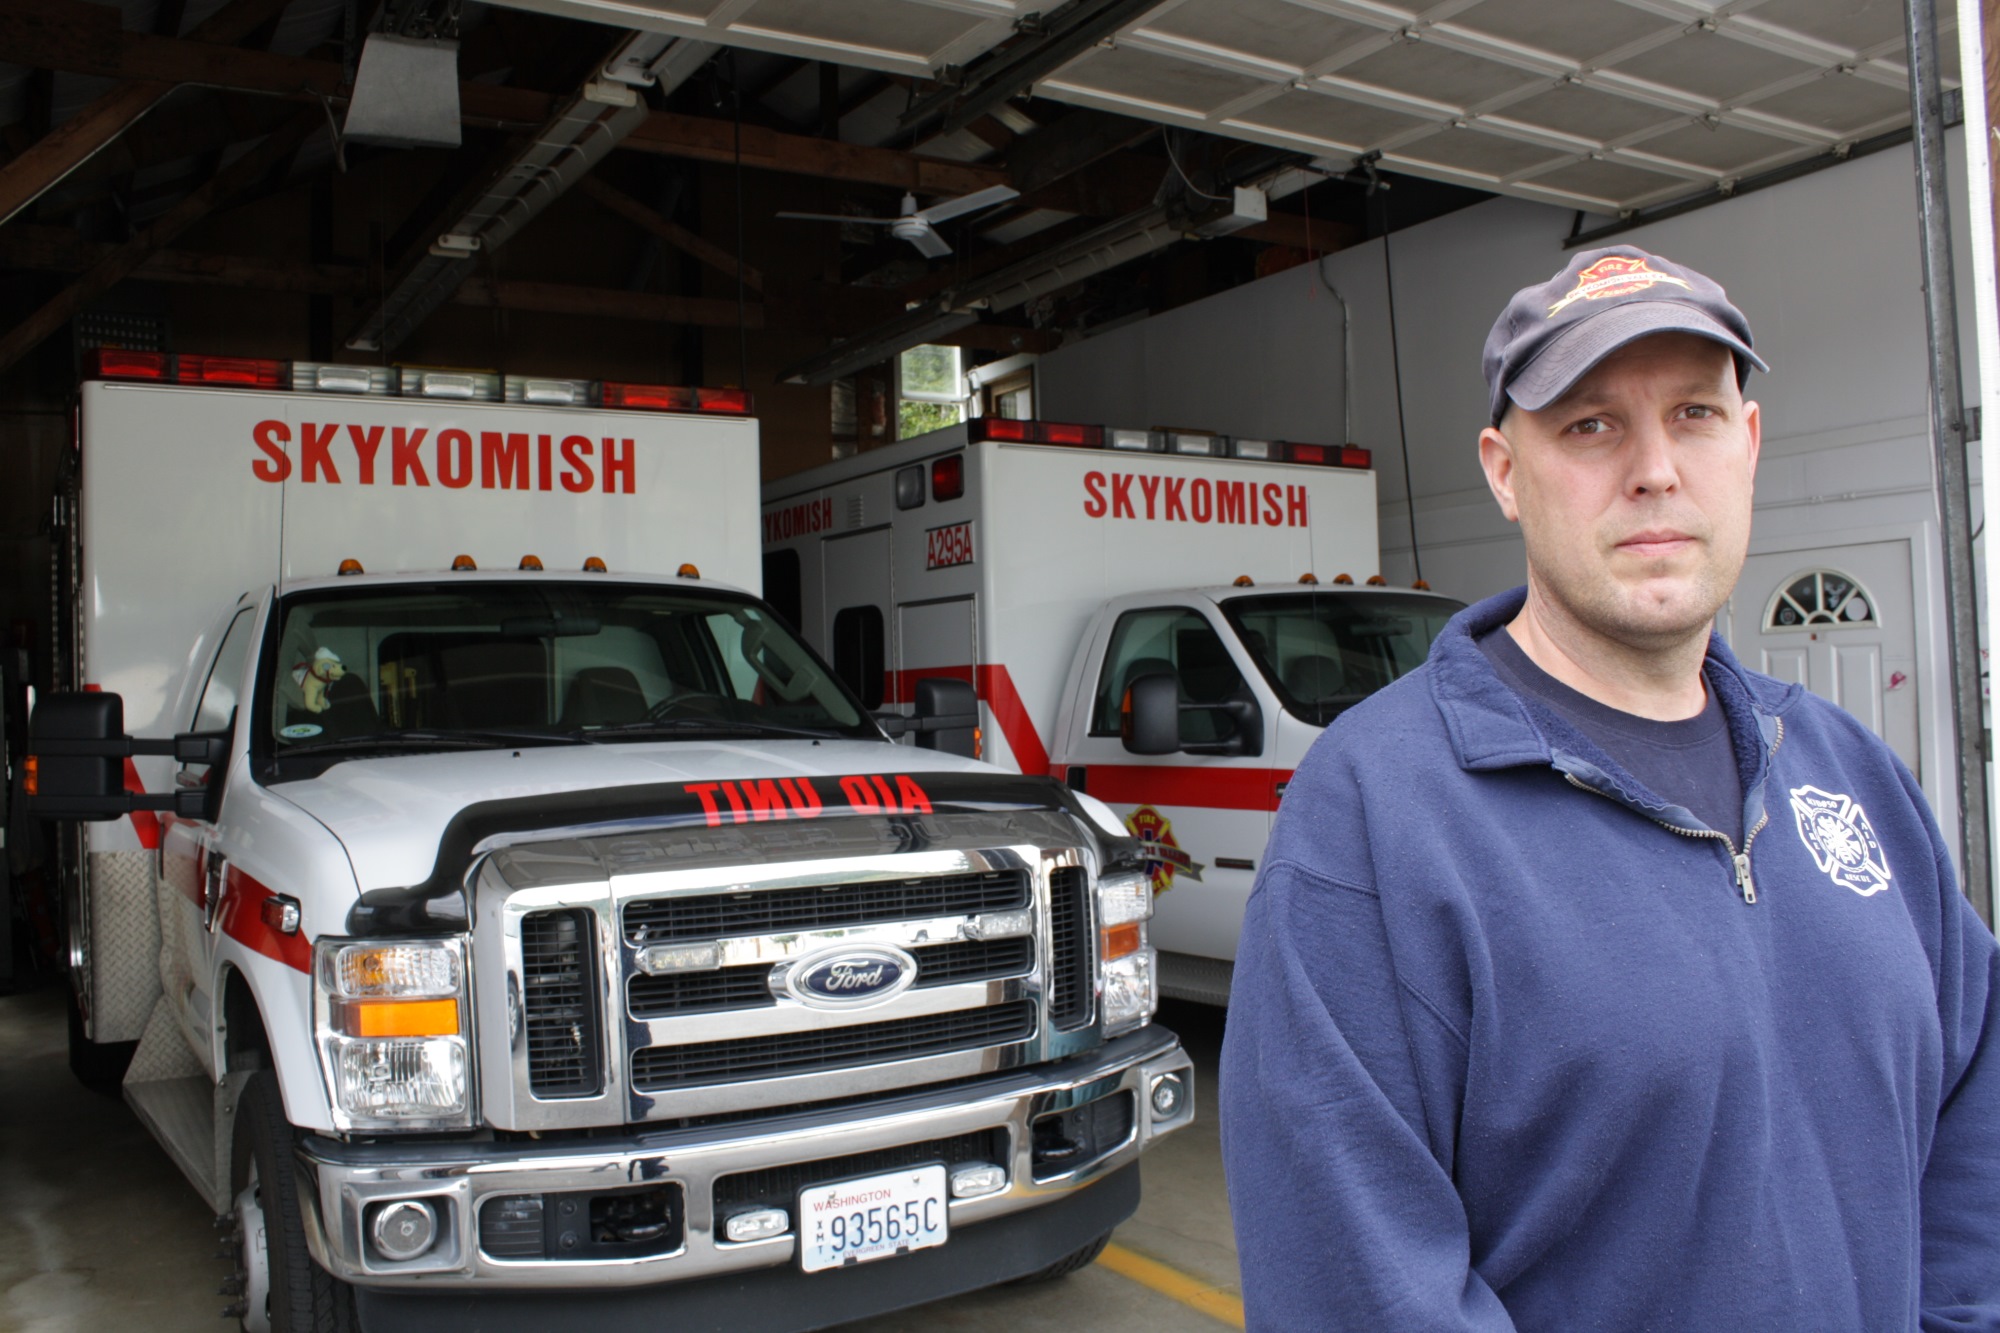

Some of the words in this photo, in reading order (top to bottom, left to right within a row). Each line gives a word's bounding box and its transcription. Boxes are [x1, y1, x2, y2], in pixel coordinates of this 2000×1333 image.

[1598, 263, 1624, 273] FIRE
[252, 420, 636, 494] SKYKOMISH
[1083, 471, 1308, 527] SKYKOMISH
[763, 498, 832, 544] YKOMISH
[927, 525, 973, 566] A295A
[1139, 814, 1155, 824] FIRE
[1861, 822, 1877, 848] AID
[825, 961, 883, 990] Ford
[813, 1189, 891, 1212] WASHINGTON
[831, 1197, 937, 1251] 93565C
[843, 1243, 885, 1257] EVERGREEN
[888, 1239, 910, 1249] STATE
